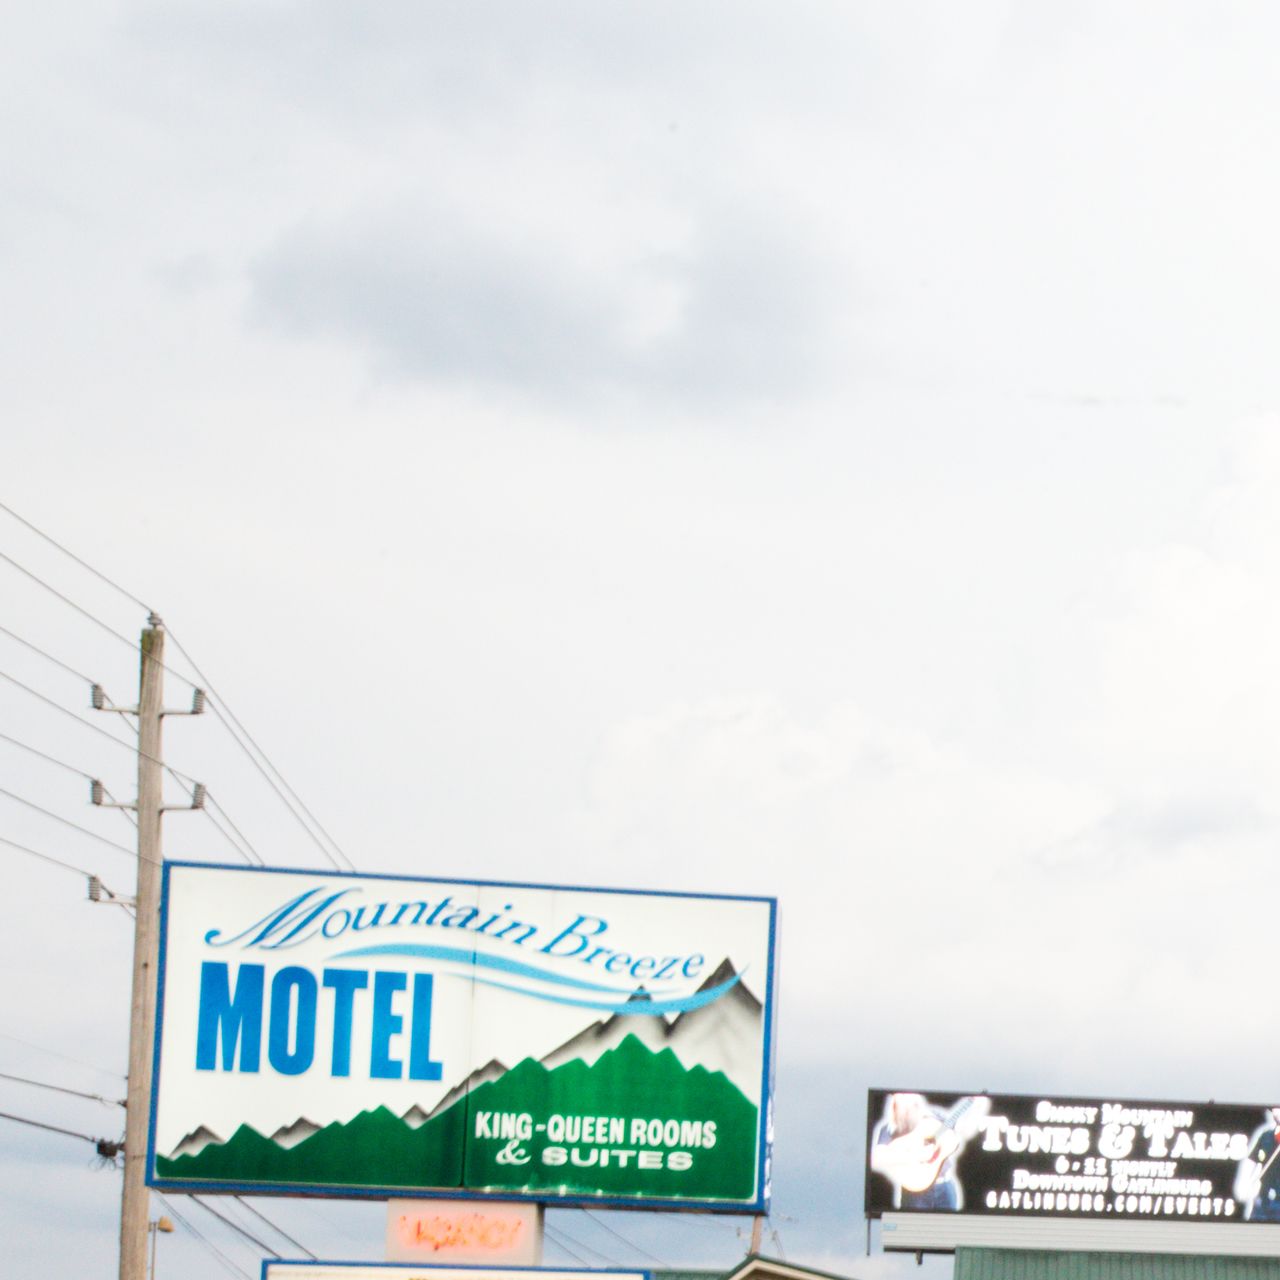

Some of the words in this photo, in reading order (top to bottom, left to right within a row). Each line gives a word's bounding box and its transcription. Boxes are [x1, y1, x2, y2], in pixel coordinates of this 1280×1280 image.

[203, 885, 537, 950] Mountain
[538, 911, 707, 982] Breeze
[195, 960, 444, 1082] MOTEL
[630, 1118, 718, 1149] ROOMS
[1098, 1124, 1136, 1159] &
[495, 1139, 532, 1166] &
[541, 1145, 694, 1171] SUITES
